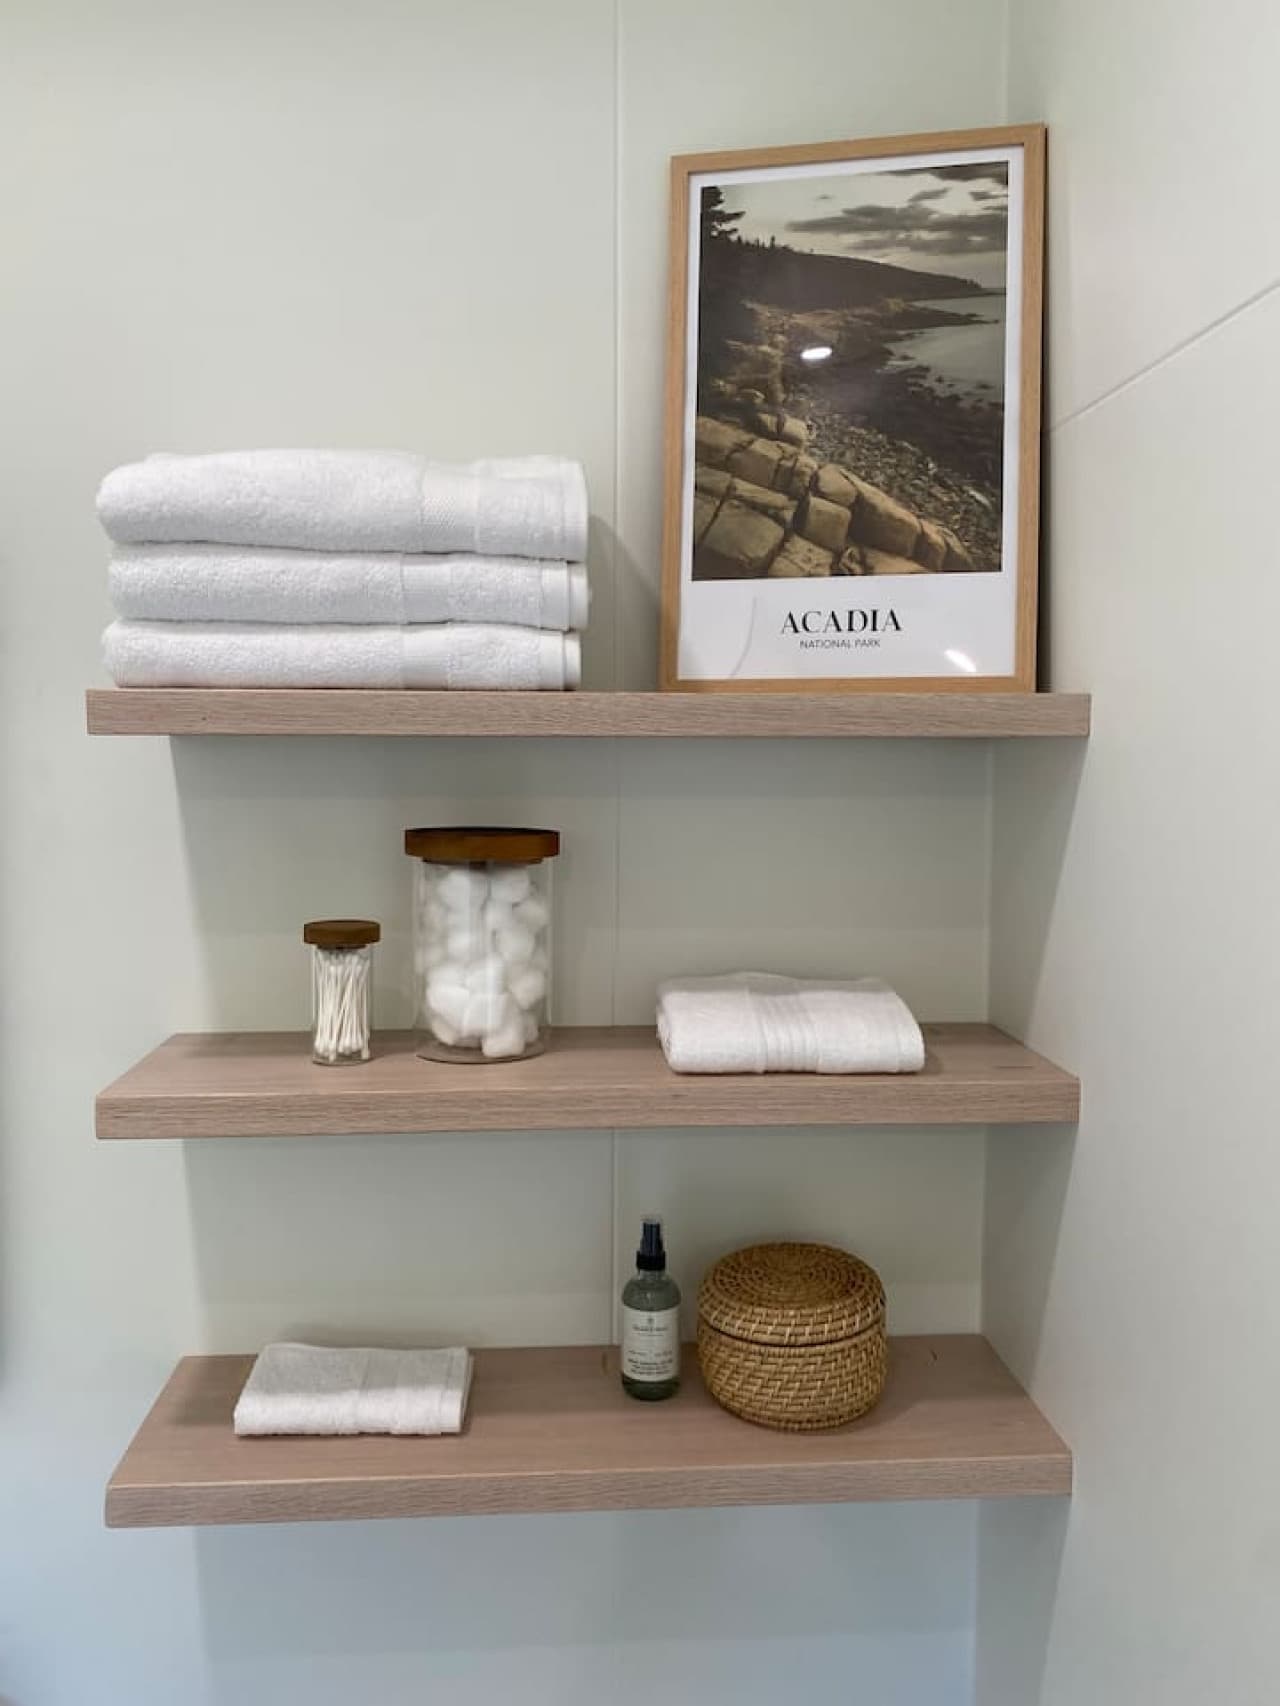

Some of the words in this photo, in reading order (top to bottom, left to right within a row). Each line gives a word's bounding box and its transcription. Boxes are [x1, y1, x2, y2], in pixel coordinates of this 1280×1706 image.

[781, 608, 903, 634] ACADIA
[799, 639, 851, 649] NATIONAL
[854, 638, 881, 648] PARK
